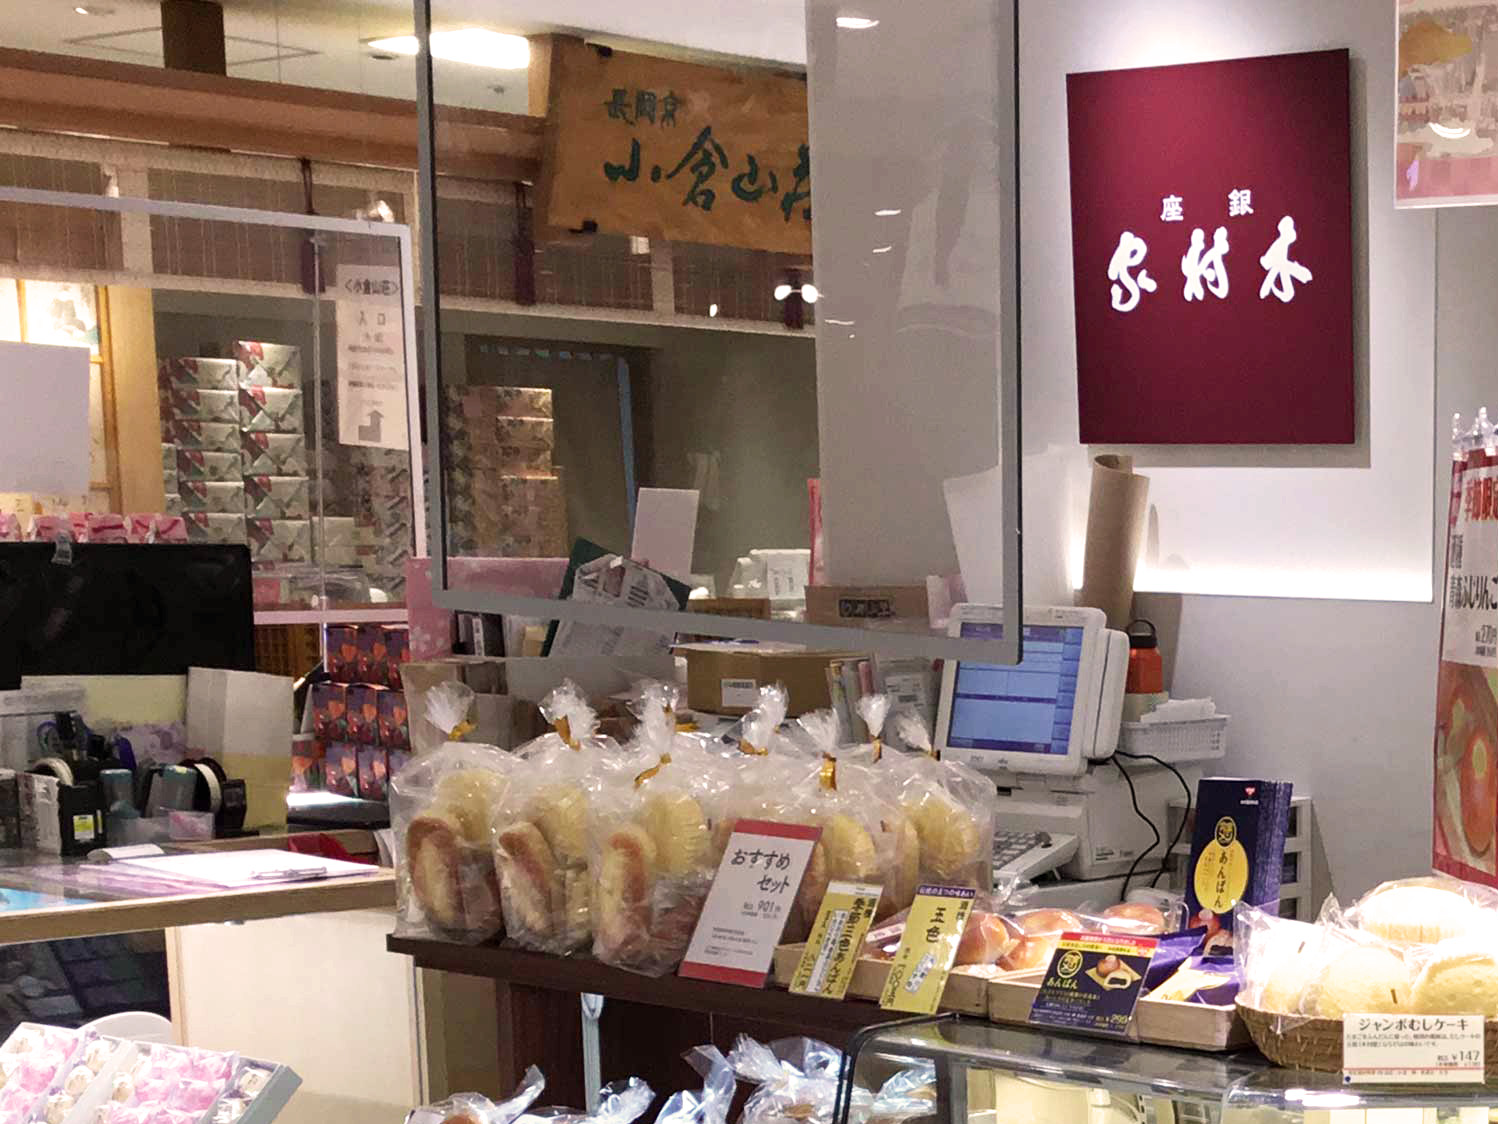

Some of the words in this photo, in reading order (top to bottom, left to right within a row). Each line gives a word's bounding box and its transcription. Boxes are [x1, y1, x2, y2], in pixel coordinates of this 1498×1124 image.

[731, 848, 791, 871] おすすめ
[757, 874, 790, 894] セット
[926, 906, 947, 943] 五色
[1359, 1018, 1469, 1032] ジャンボむしケーキ
